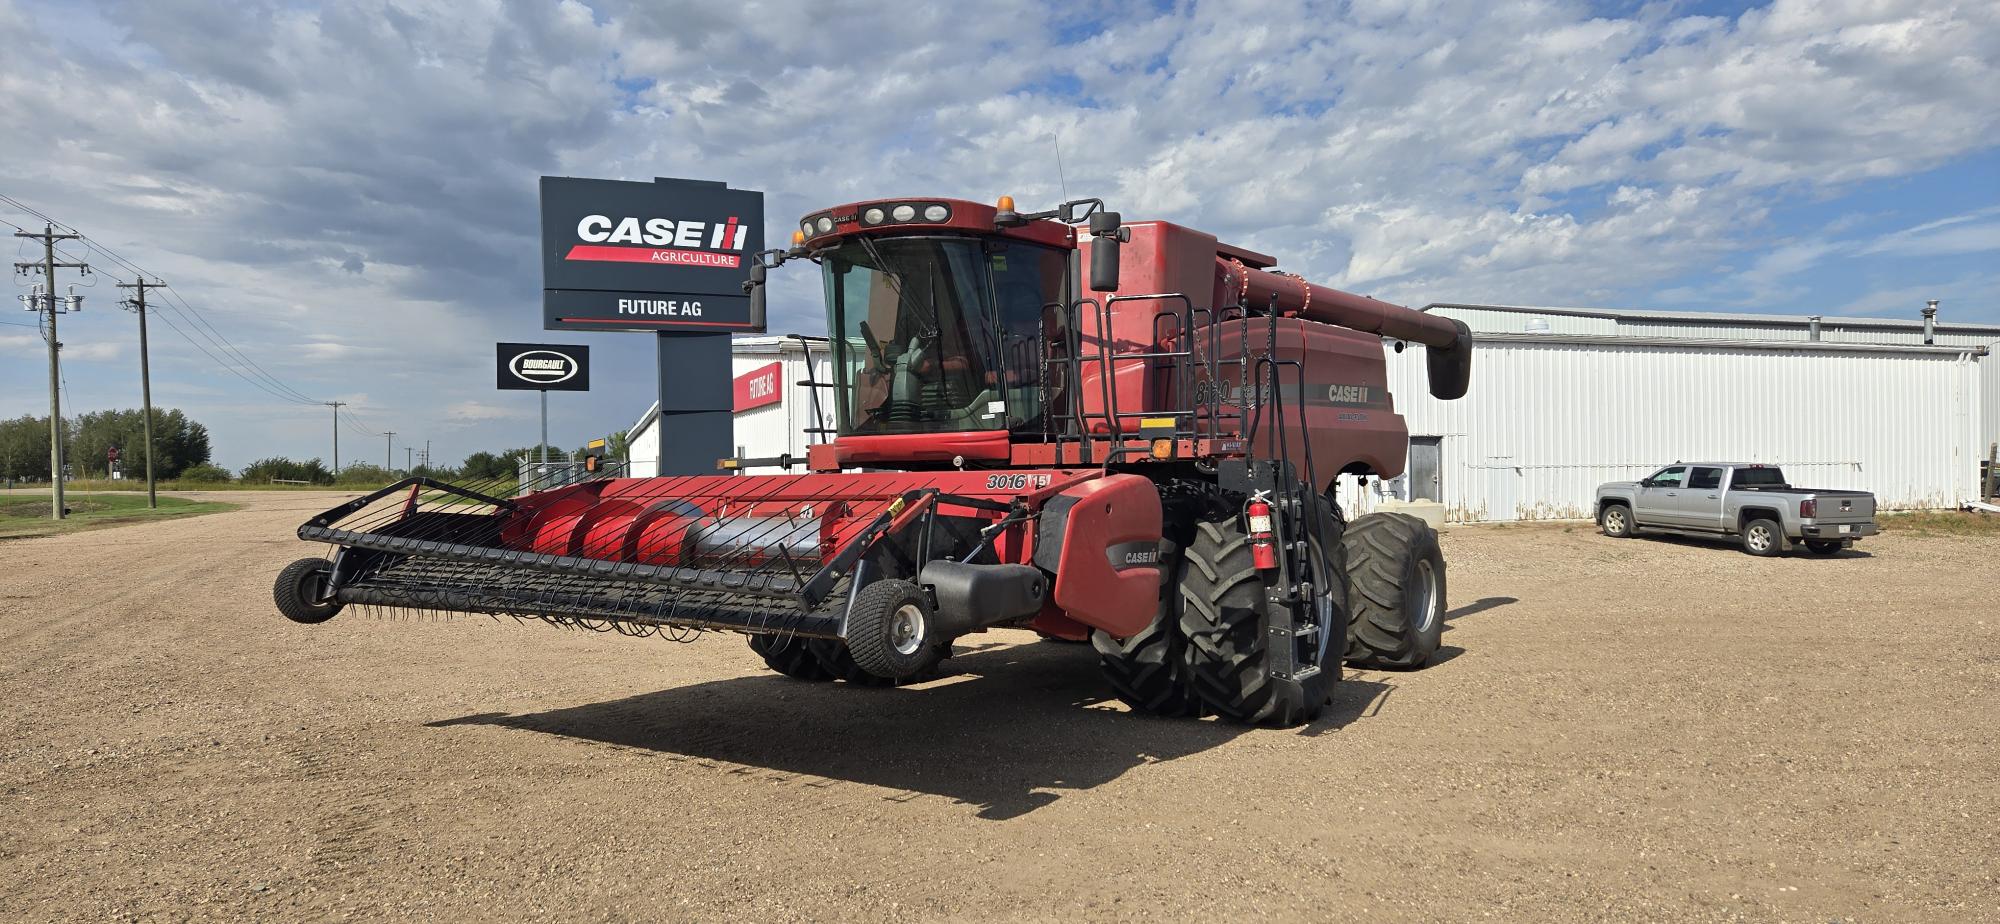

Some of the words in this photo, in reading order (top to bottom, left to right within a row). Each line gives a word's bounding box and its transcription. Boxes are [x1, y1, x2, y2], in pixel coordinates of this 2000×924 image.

[577, 214, 706, 248] CASE
[709, 216, 748, 251] IH
[651, 251, 735, 266] AGRICULTURE
[618, 298, 678, 316] FUTURE
[680, 301, 702, 317] AG
[522, 359, 565, 370] BOURGAULT
[749, 375, 766, 400] FUTURE
[766, 372, 774, 395] AG
[1196, 379, 1231, 406] 80
[1328, 384, 1359, 402] CASE
[986, 473, 1027, 490] 3016
[1125, 552, 1149, 564] CASE
